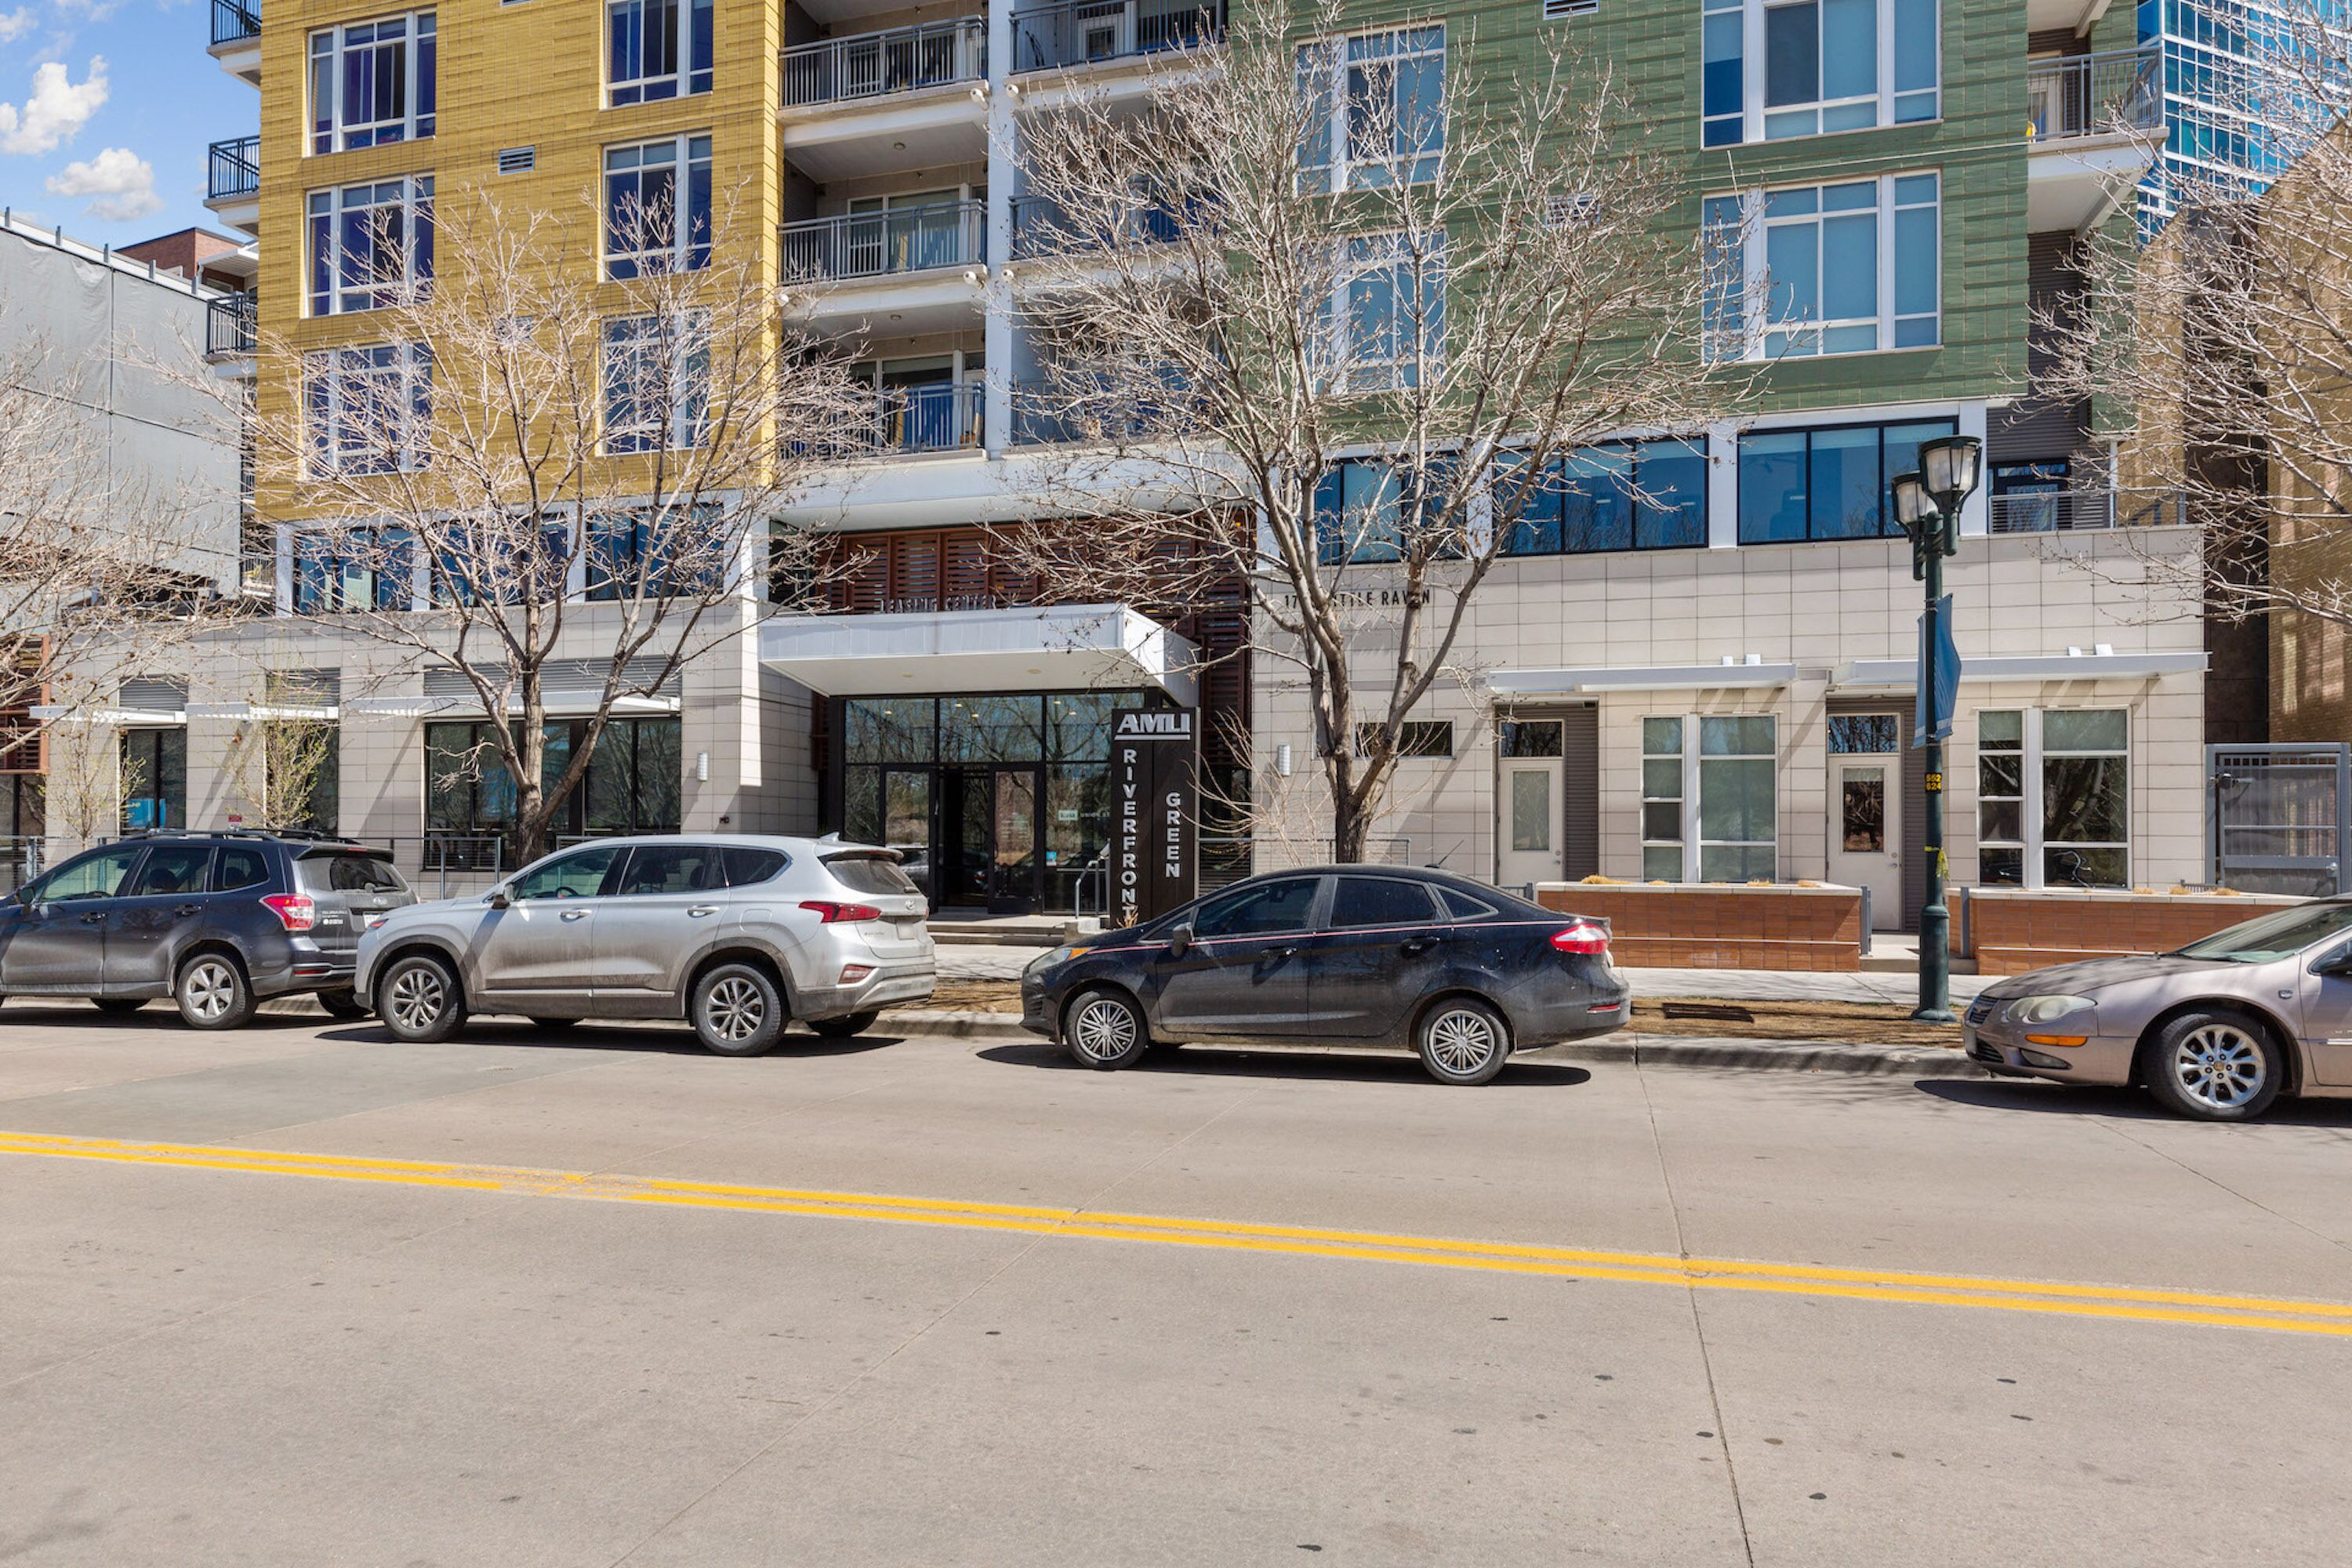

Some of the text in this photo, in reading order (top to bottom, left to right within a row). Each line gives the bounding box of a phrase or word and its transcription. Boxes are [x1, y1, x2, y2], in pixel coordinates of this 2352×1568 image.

[1381, 590, 1430, 605] RAVN
[1116, 713, 1191, 733] AMLI
[1120, 749, 1138, 920] RIVERFRONT
[1165, 792, 1181, 879] GREEN
